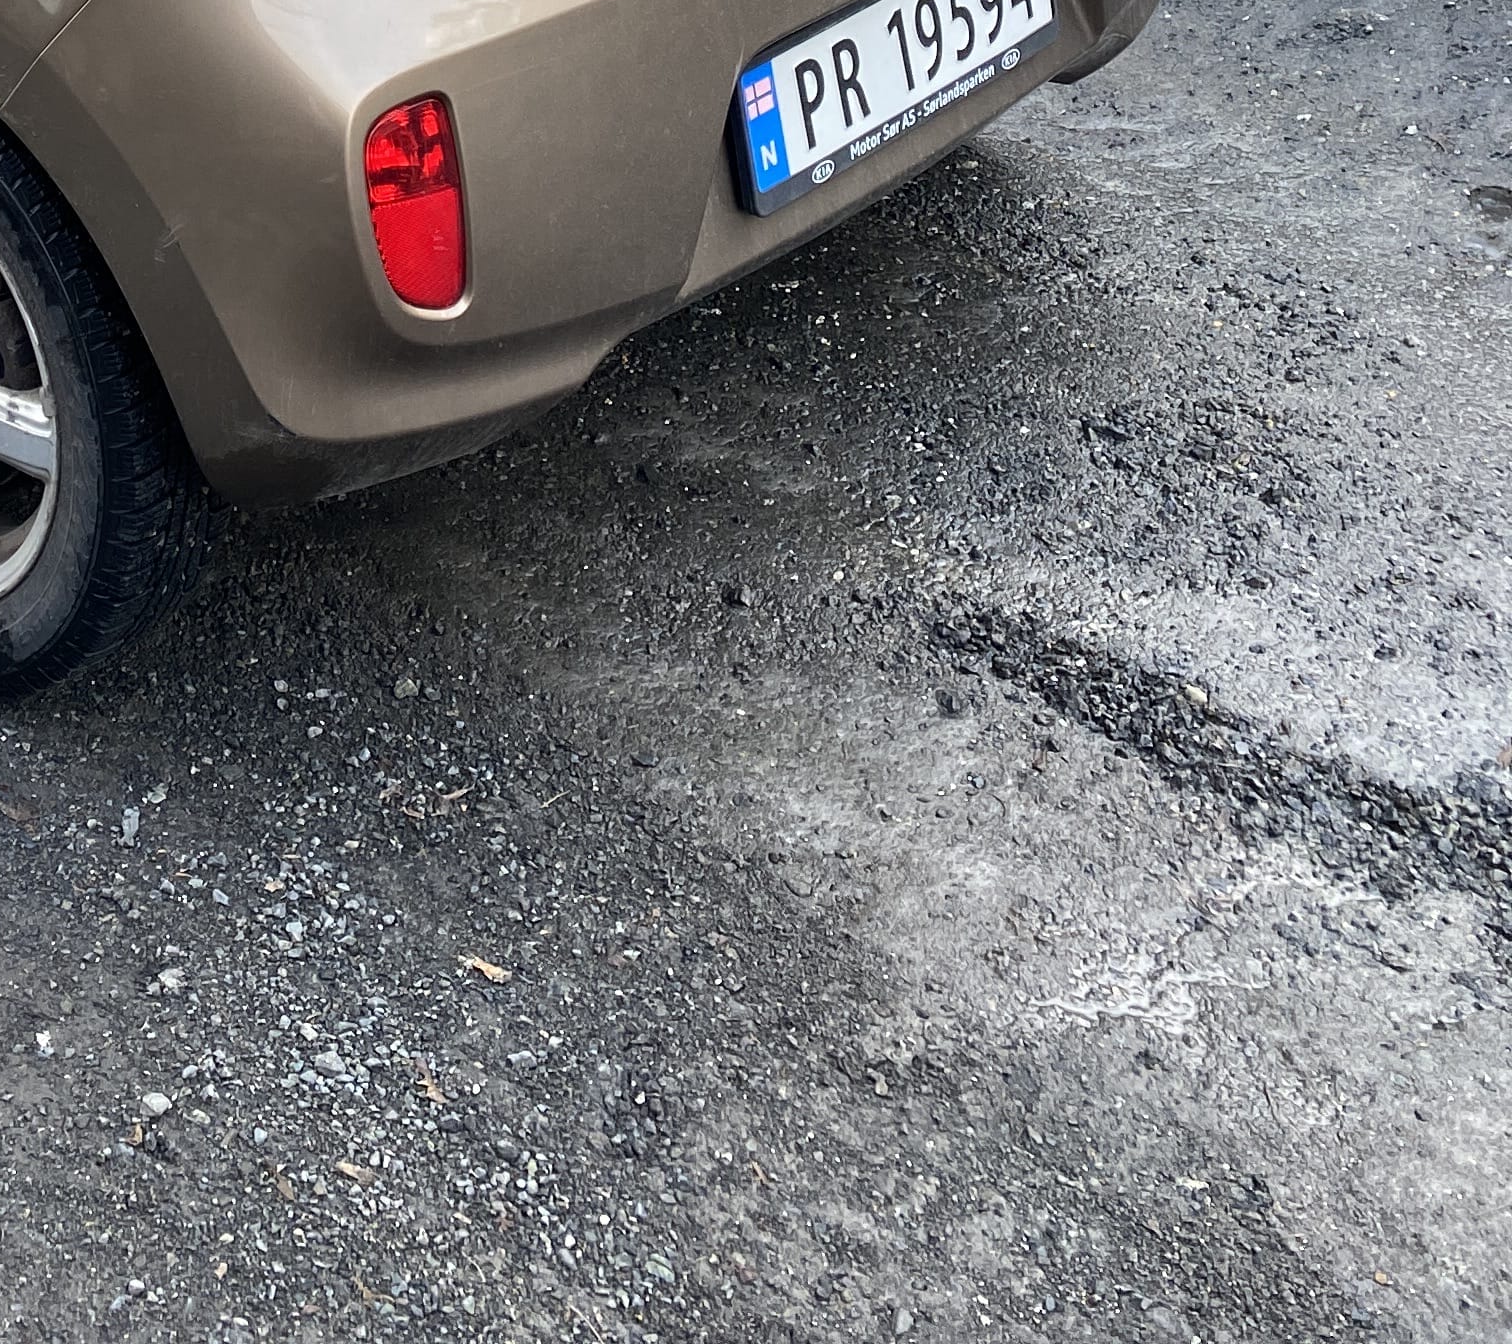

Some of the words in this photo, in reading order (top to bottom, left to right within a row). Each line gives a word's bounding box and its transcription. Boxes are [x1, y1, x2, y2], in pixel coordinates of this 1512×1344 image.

[760, 139, 778, 171] N
[794, 38, 872, 151] PR
[813, 161, 833, 181] KIA
[850, 132, 882, 161] Motor
[882, 119, 901, 142] Sør
[901, 108, 916, 131] AS
[922, 64, 995, 118] Sørlandsparken
[1003, 51, 1019, 68] KIA
